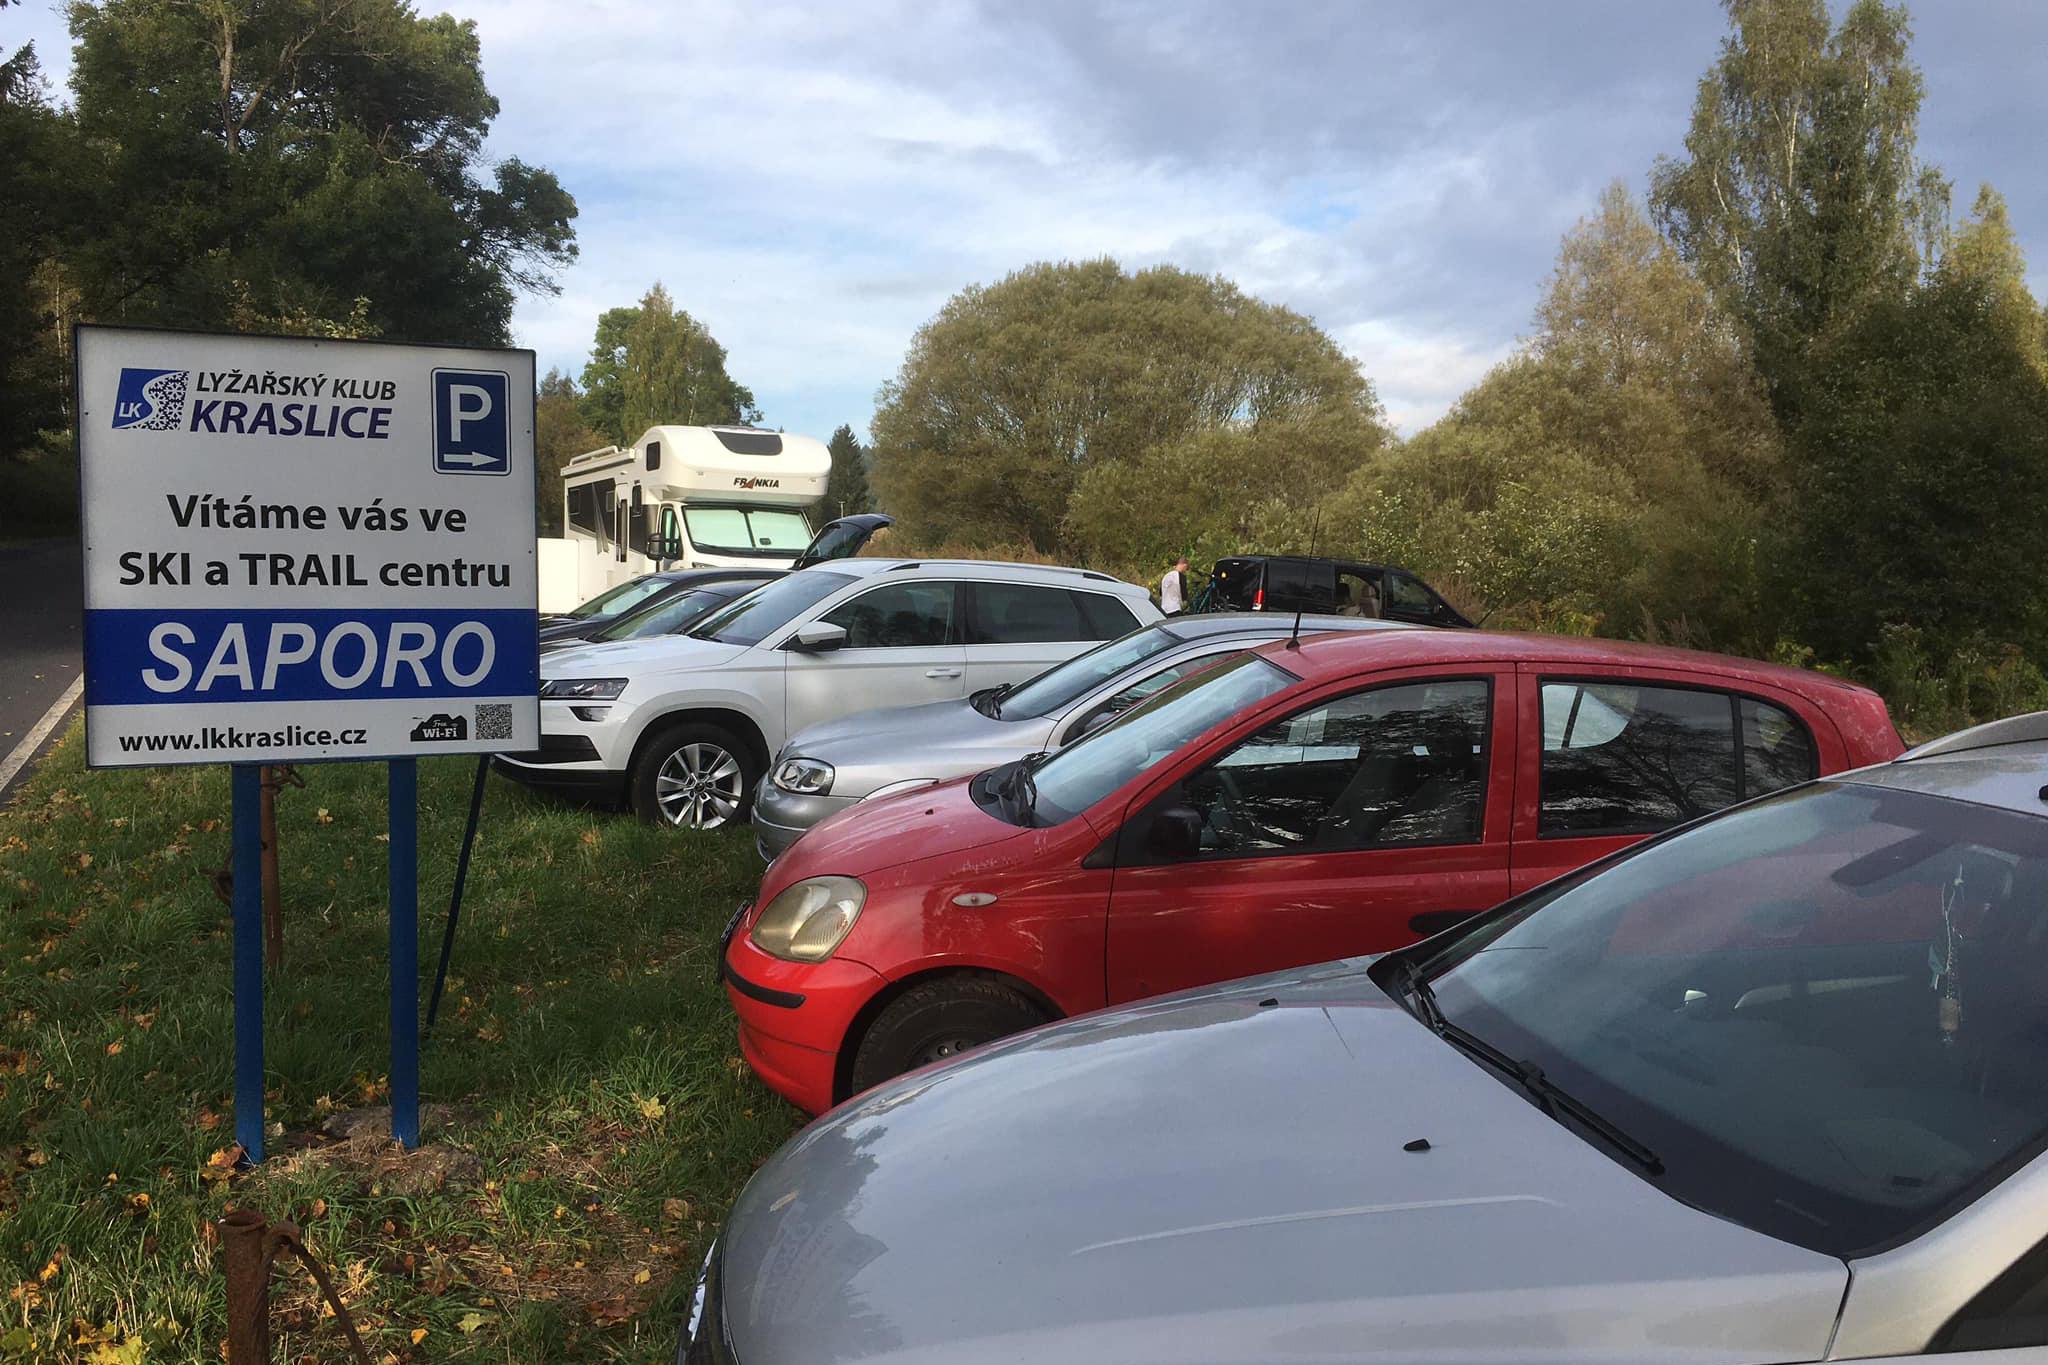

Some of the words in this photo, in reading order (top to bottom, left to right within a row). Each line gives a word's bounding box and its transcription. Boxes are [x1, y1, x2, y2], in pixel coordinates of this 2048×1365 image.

[196, 369, 328, 397] LYŽAŘSKÝ
[331, 379, 397, 400] KLUB
[189, 399, 393, 440] KRASLICE
[449, 383, 493, 443] P
[166, 494, 327, 530] Vítáme
[337, 497, 409, 532] vás
[418, 508, 467, 533] ve
[119, 551, 191, 586] SKI
[204, 560, 229, 586] a
[238, 553, 369, 587] TRAIL
[379, 557, 510, 588] centru
[141, 620, 497, 693] SAPORO
[118, 725, 367, 752] www.lkkraslice.cz
[422, 728, 457, 738] Wi-Fi
